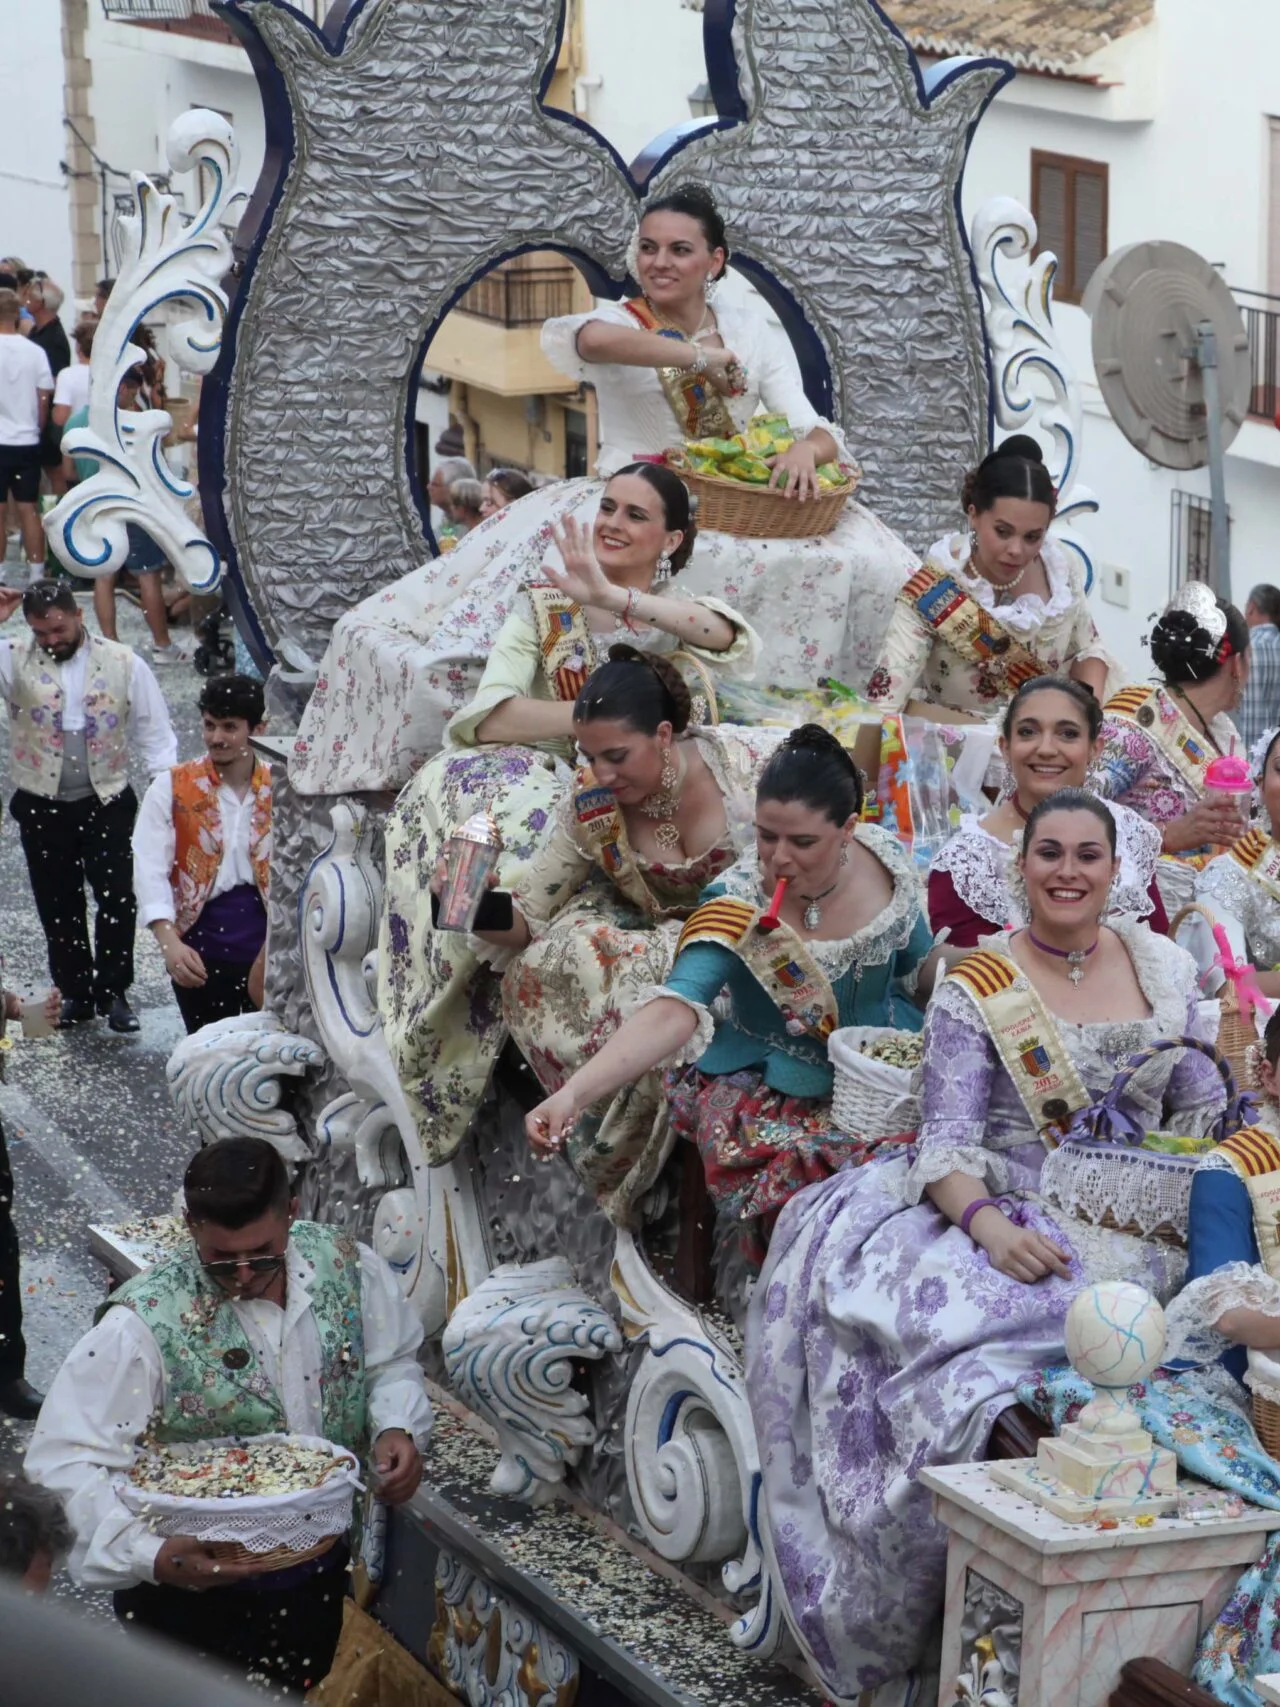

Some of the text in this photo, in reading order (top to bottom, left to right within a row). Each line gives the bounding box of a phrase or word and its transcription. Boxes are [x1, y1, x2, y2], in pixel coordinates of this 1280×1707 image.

[953, 614, 974, 635] 2013
[588, 816, 612, 833] 2013
[1033, 1074, 1060, 1090] 2013
